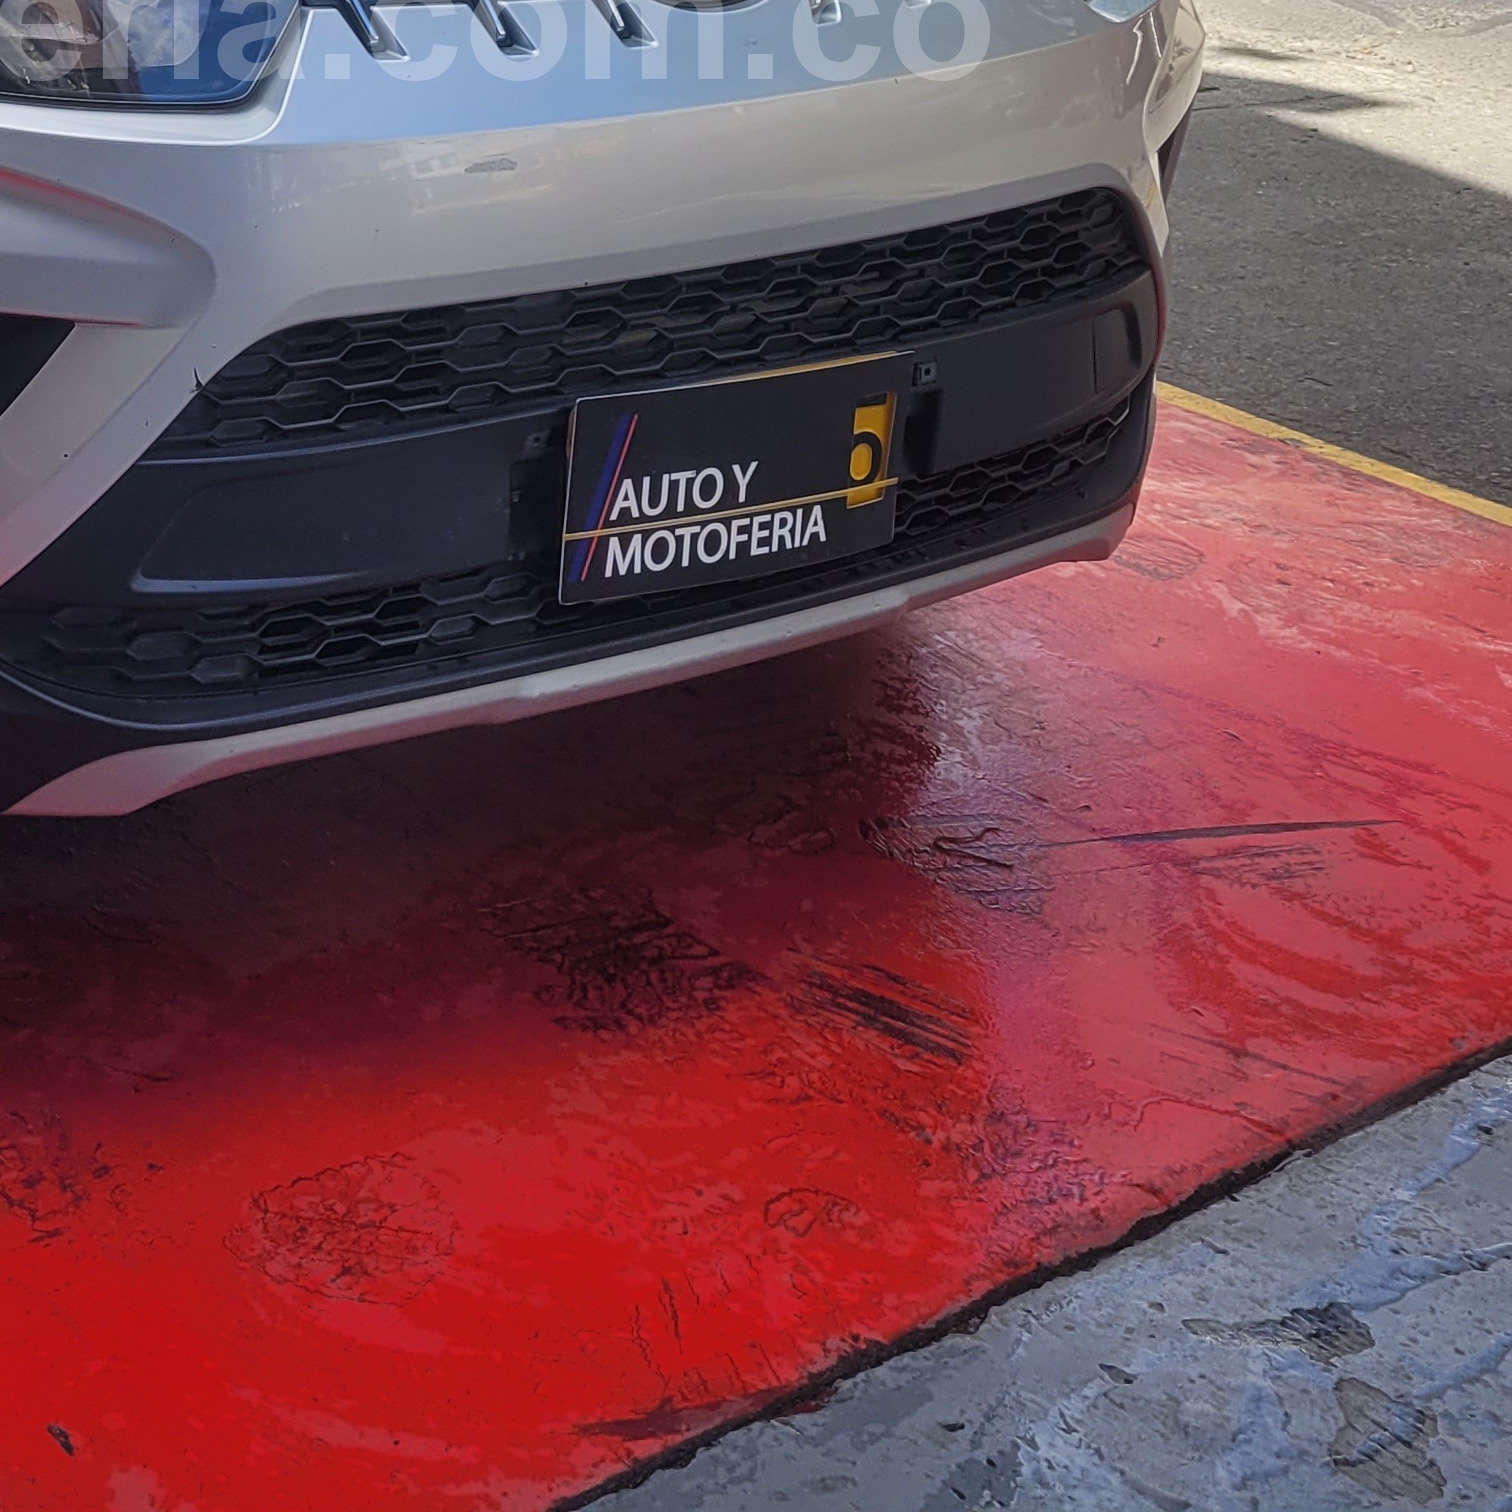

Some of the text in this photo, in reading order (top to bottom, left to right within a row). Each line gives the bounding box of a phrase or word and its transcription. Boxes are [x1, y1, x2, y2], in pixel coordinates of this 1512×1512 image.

[609, 460, 759, 521] AUTO Y
[604, 504, 827, 579] MOTOFERIA
